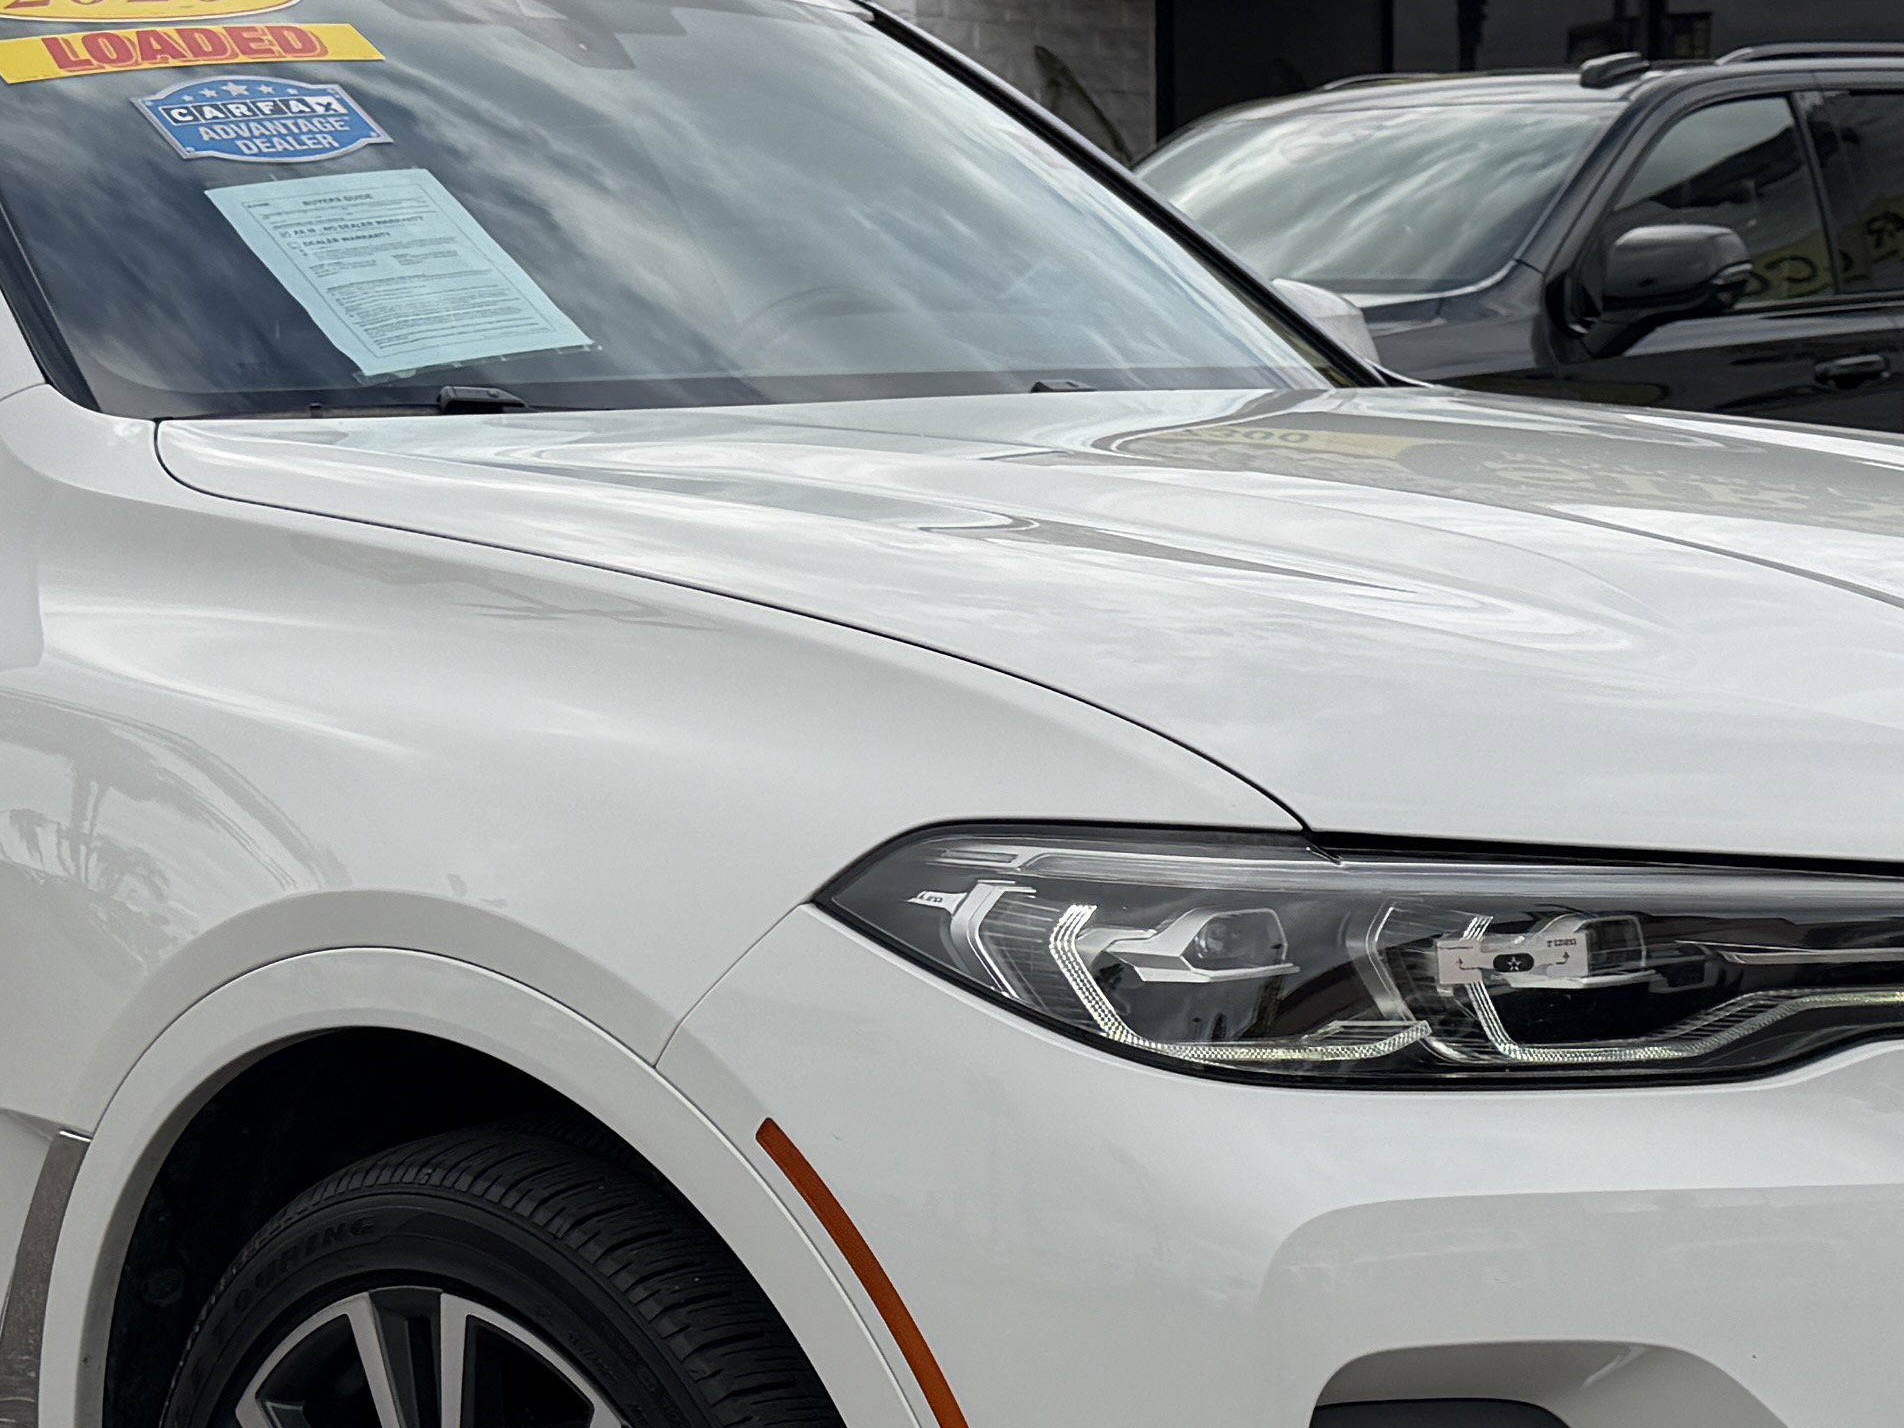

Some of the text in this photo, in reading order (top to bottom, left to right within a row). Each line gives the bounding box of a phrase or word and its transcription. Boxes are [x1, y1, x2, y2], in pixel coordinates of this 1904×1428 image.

[41, 24, 328, 73] LOADED
[167, 97, 339, 123] CARFAX
[197, 116, 349, 141] ADVANTAGE
[235, 133, 340, 155] DEALER
